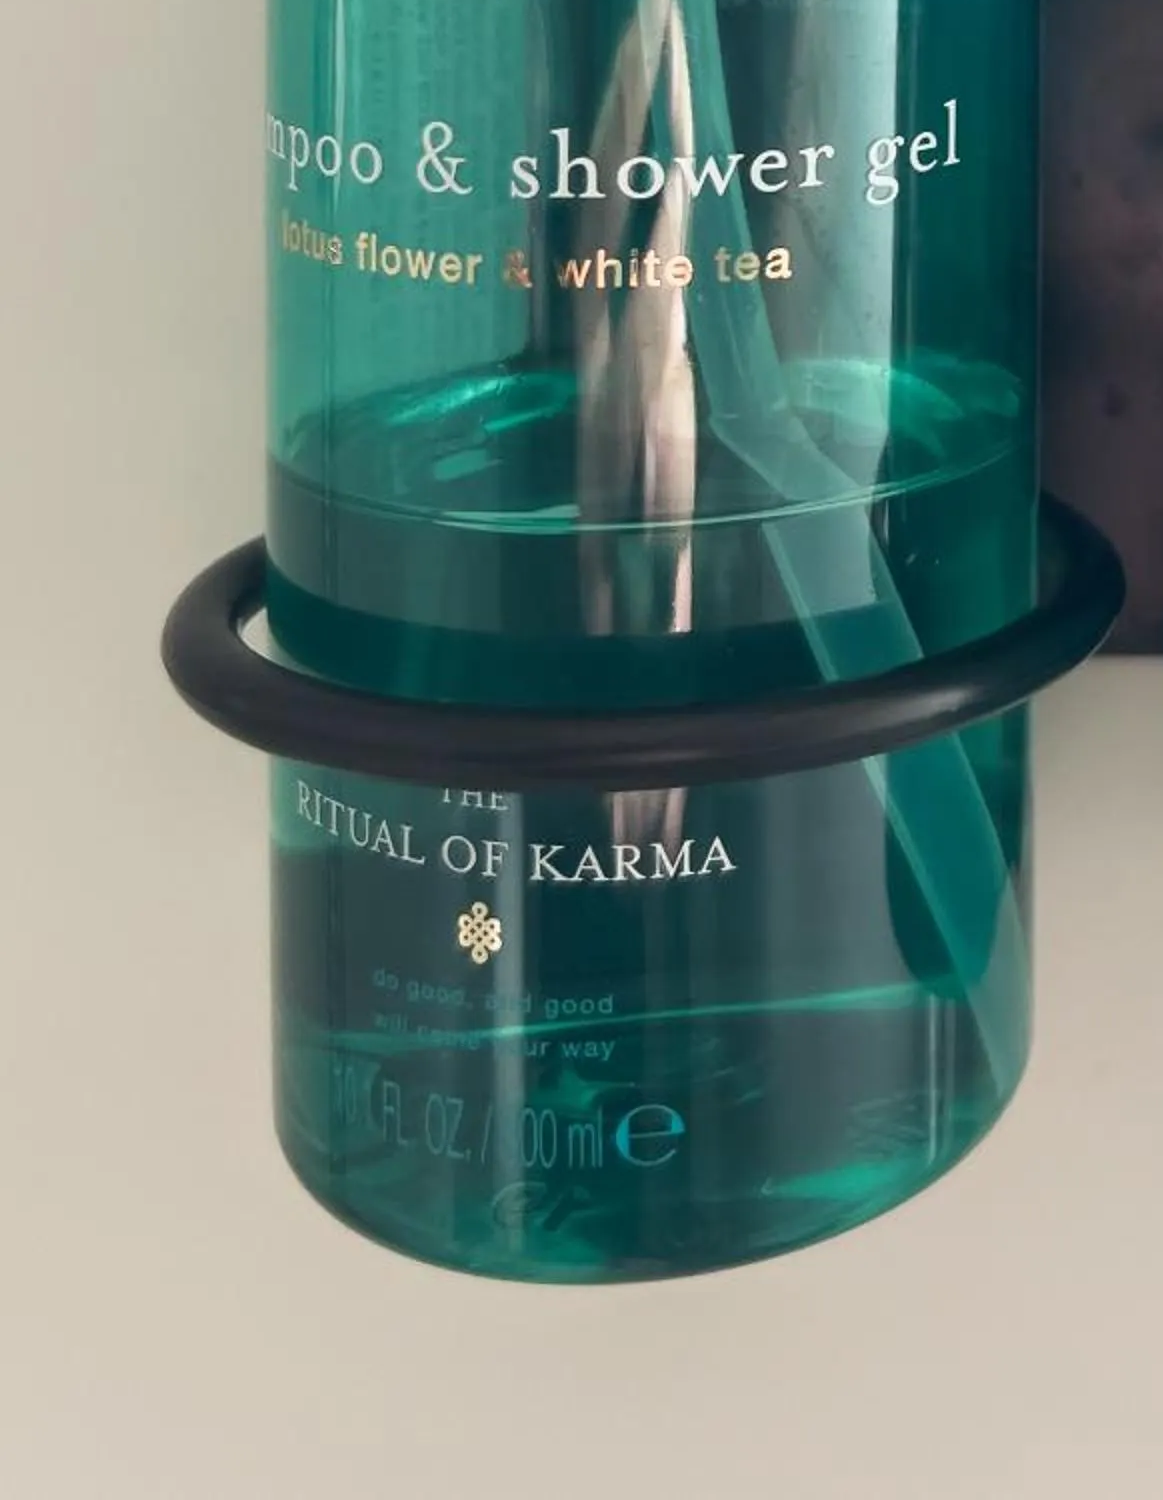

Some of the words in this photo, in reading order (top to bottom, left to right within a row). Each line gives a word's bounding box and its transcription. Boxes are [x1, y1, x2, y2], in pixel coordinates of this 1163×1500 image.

[416, 120, 474, 196] &
[509, 128, 836, 200] shower
[865, 100, 962, 205] gel
[281, 209, 345, 266] lotus
[355, 231, 482, 287] flower
[503, 247, 533, 289] &
[557, 247, 694, 290] white
[714, 243, 792, 284] tea
[296, 779, 426, 866] RITUAL
[441, 834, 510, 878] OF
[528, 834, 738, 883] KARMA
[373, 969, 400, 991] do
[545, 992, 614, 1020] good
[561, 1040, 617, 1062] way
[503, 1105, 558, 1169] 00
[568, 1103, 604, 1169] ml
